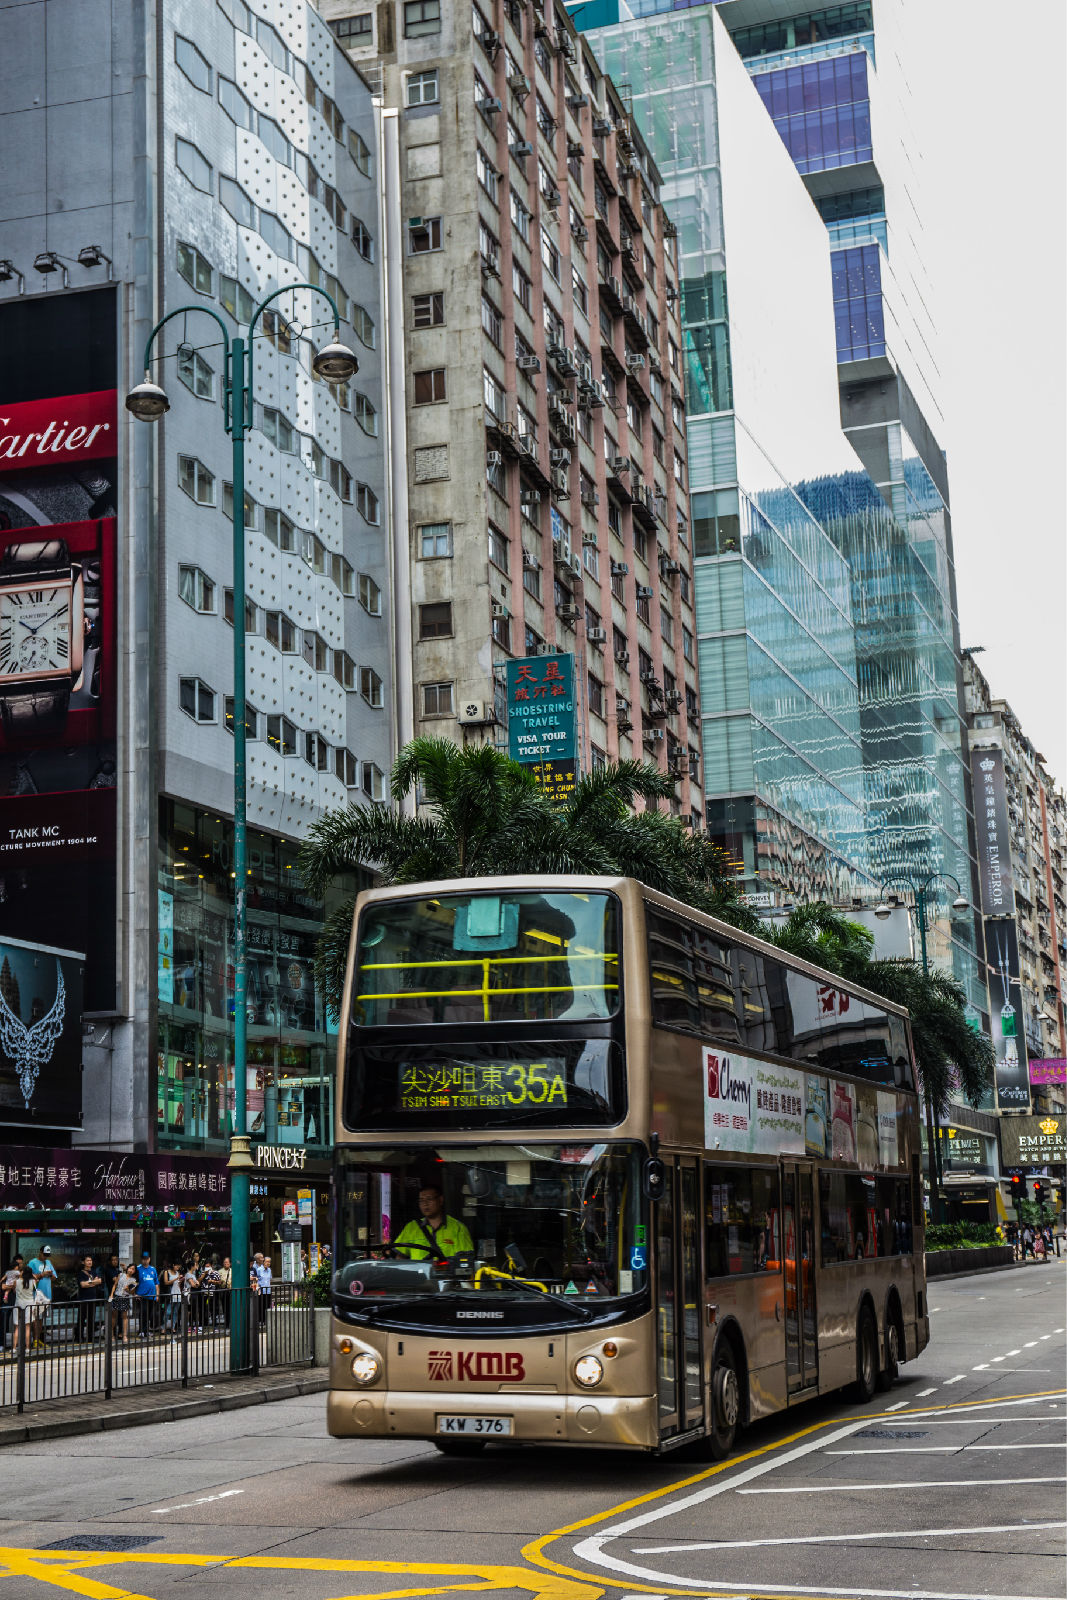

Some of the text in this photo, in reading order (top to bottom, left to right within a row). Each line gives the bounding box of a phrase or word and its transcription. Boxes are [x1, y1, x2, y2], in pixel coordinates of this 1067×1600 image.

[509, 701, 573, 717] SHOESTRING
[522, 715, 561, 728] TRAVEL
[517, 731, 567, 744] VISA TOUR
[518, 745, 551, 756] TICKET
[9, 825, 60, 839] TANK MC
[25, 839, 65, 849] MOVEMENT
[989, 844, 1003, 906] EMPEROR
[402, 1065, 505, 1094] 尖沙咀東
[506, 1063, 568, 1103] 35A
[720, 1057, 751, 1120] Cherry
[401, 1094, 507, 1108] TSIM SHA TSUI EAST
[93, 1156, 138, 1190] Harbour
[105, 1188, 139, 1200] PINNACLE
[456, 1311, 504, 1319] DENNIS
[457, 1351, 526, 1381] KMB
[446, 1418, 503, 1433] KW 376
